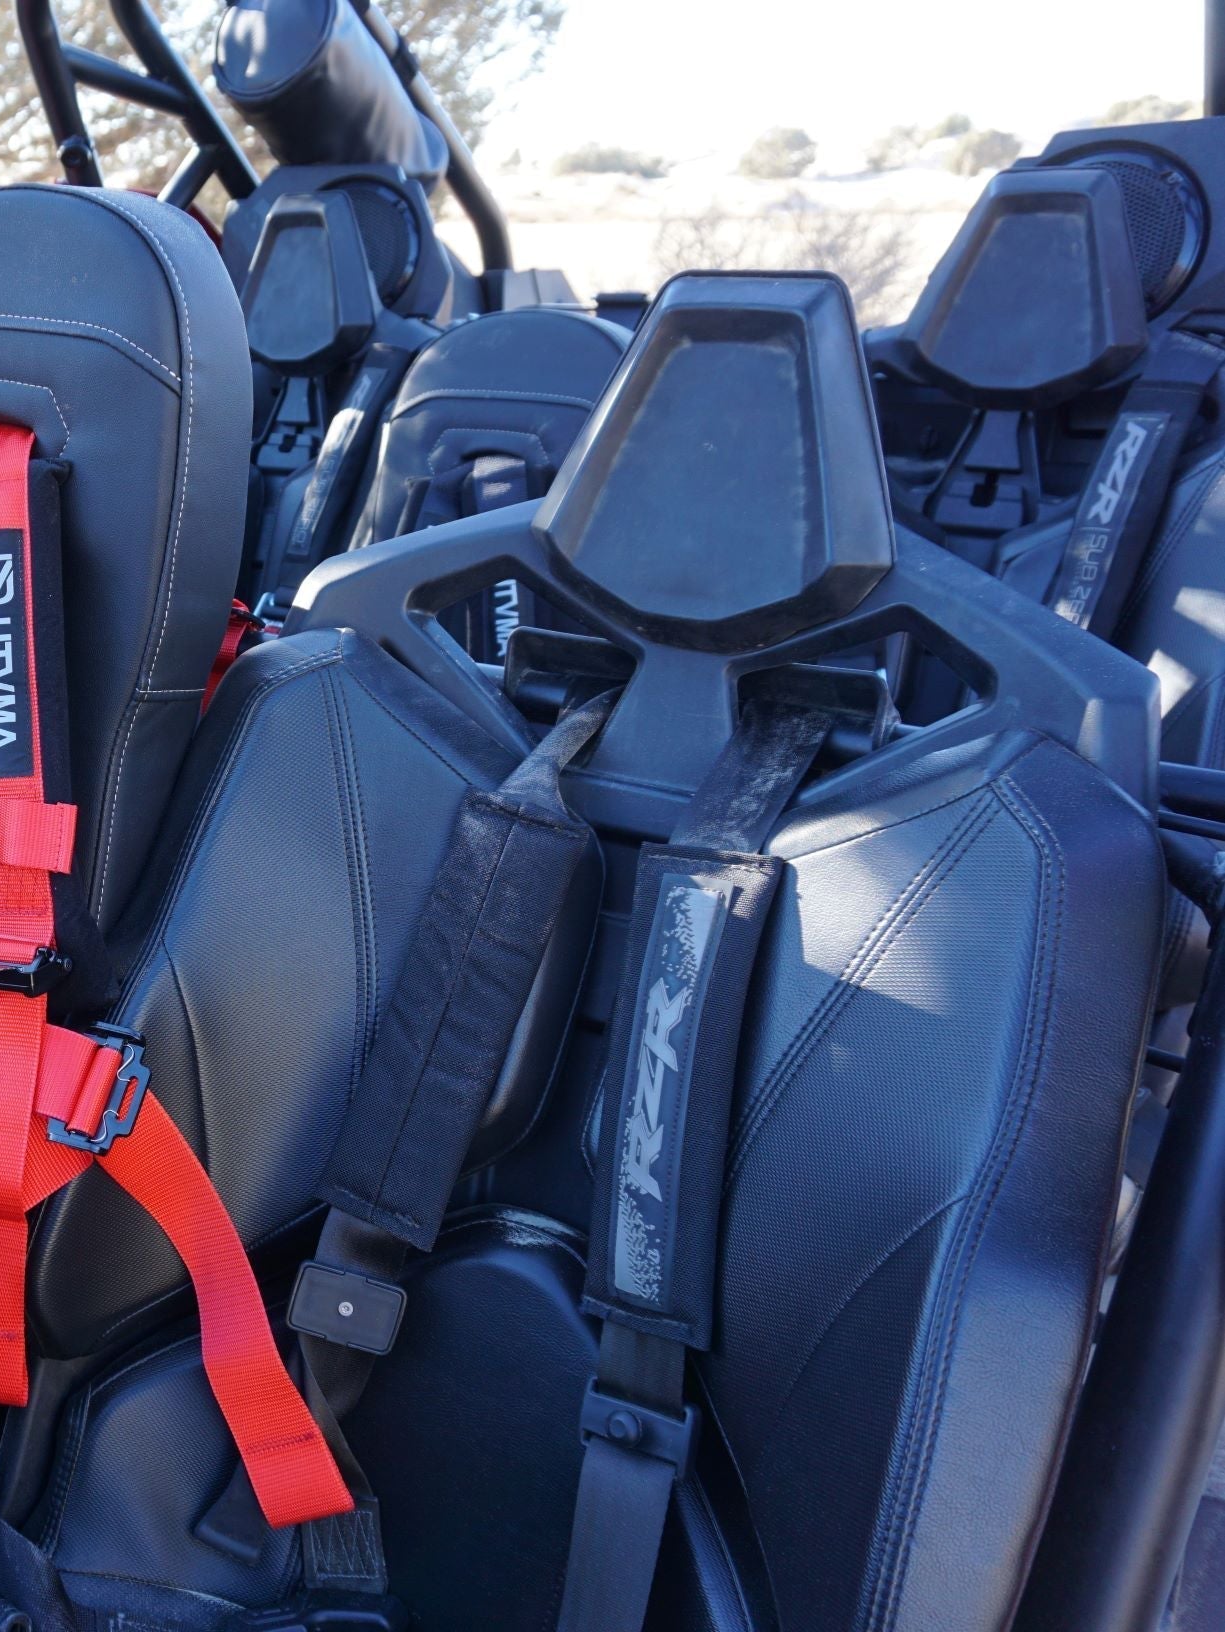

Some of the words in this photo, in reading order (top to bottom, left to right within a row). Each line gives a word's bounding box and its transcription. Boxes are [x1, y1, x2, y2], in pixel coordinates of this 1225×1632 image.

[1087, 422, 1147, 524] RZR
[1081, 534, 1108, 580] SUB
[627, 977, 687, 1201] RZR
